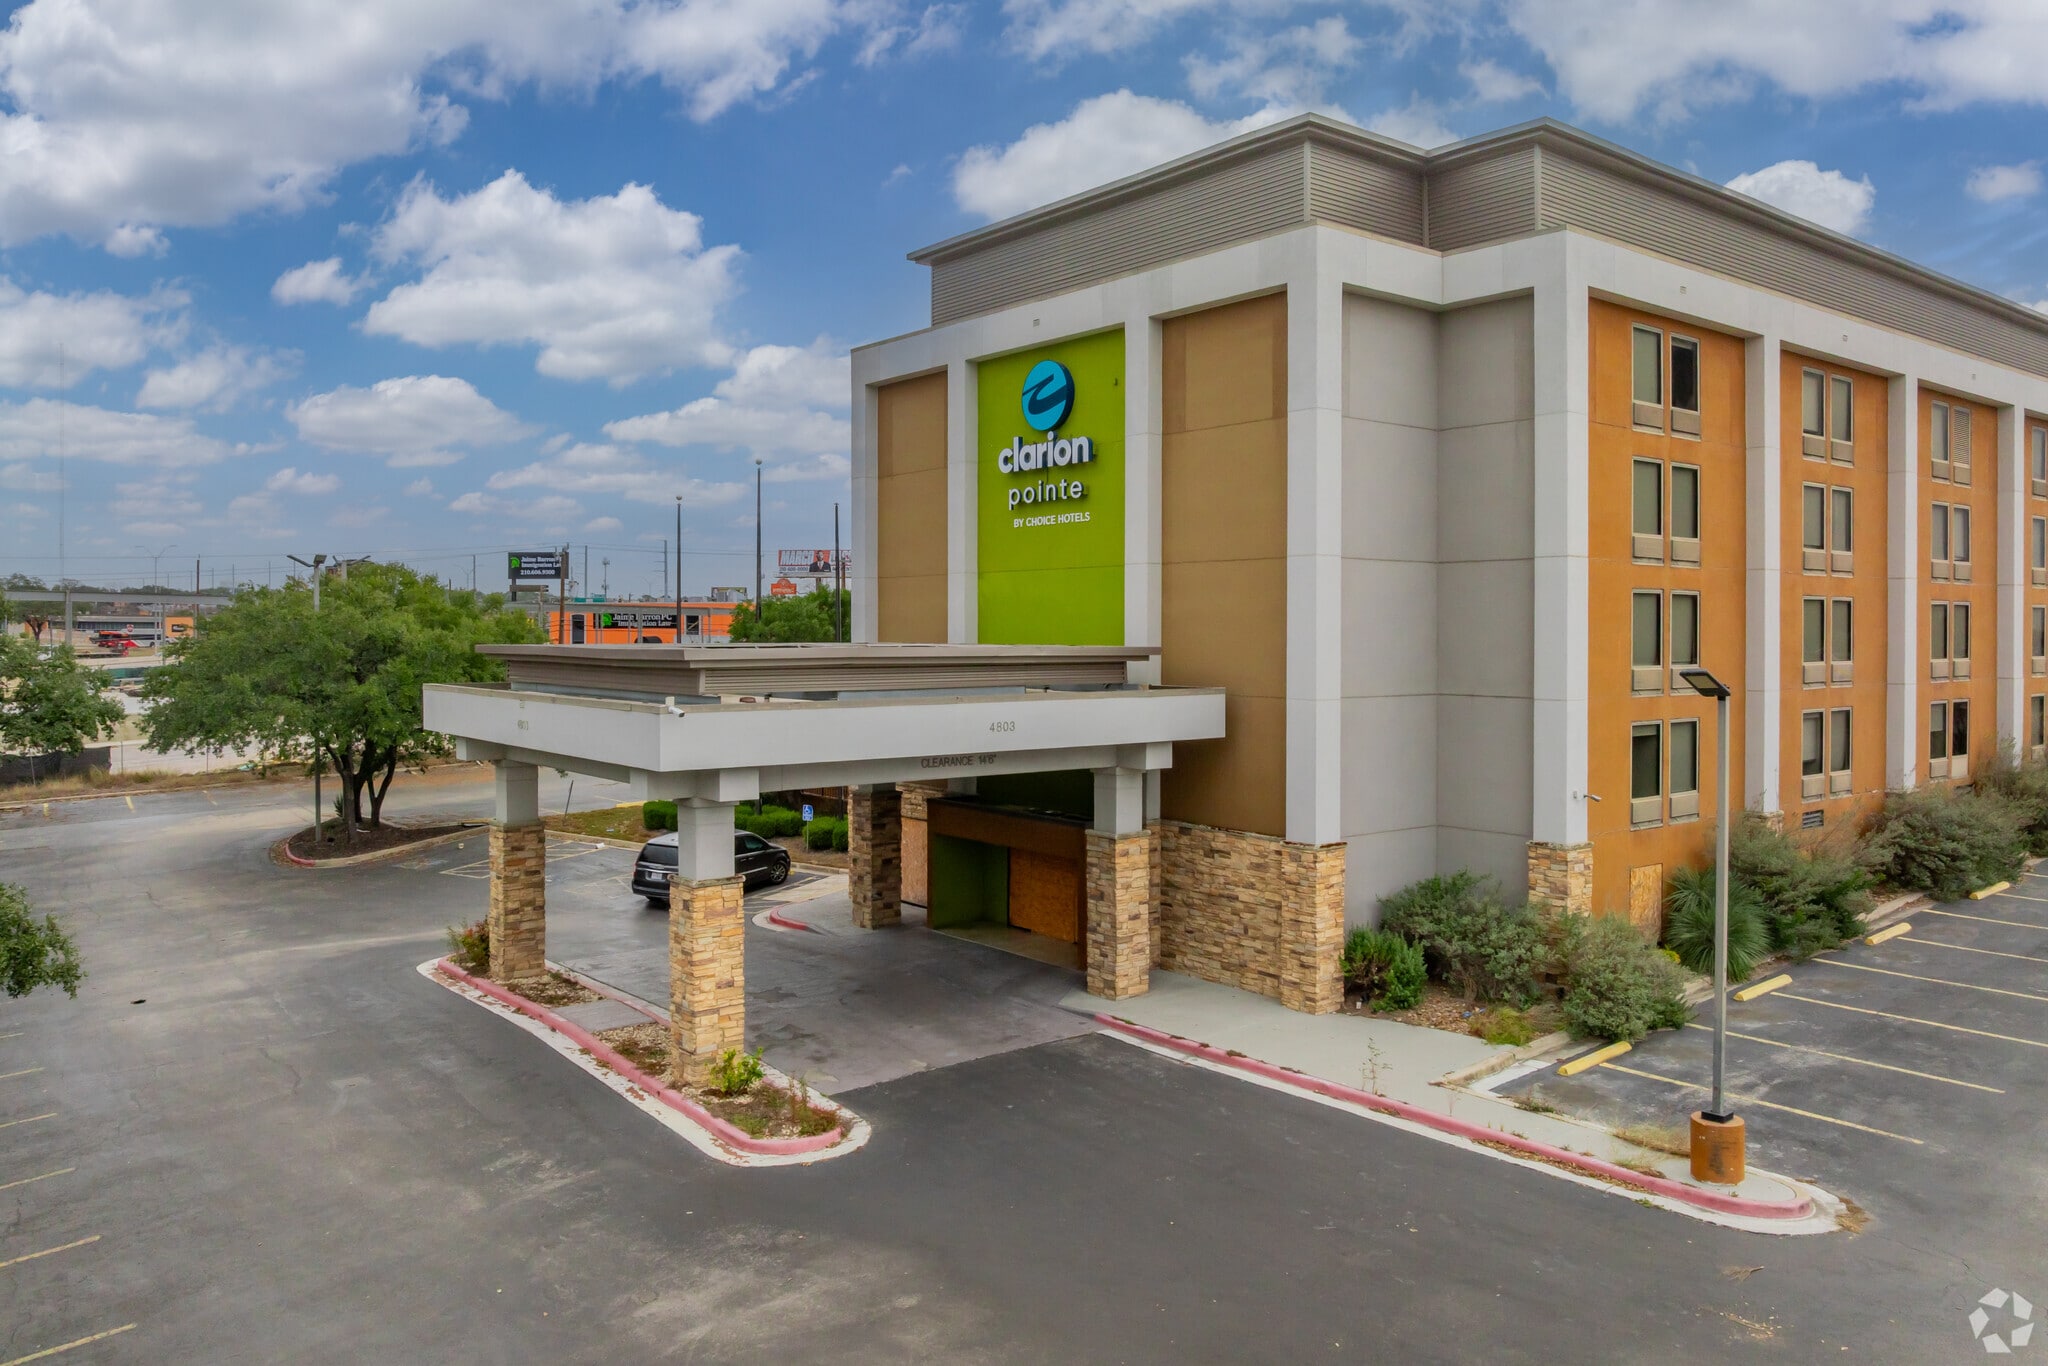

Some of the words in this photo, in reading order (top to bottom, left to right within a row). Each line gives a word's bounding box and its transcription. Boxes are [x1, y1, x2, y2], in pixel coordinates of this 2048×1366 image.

[998, 431, 1092, 474] clarion
[1008, 479, 1084, 511] pointe
[1013, 518, 1025, 528] BY
[1025, 515, 1057, 527] CHOICE
[1057, 512, 1091, 525] HOTELS
[921, 755, 973, 768] CLEARANCE
